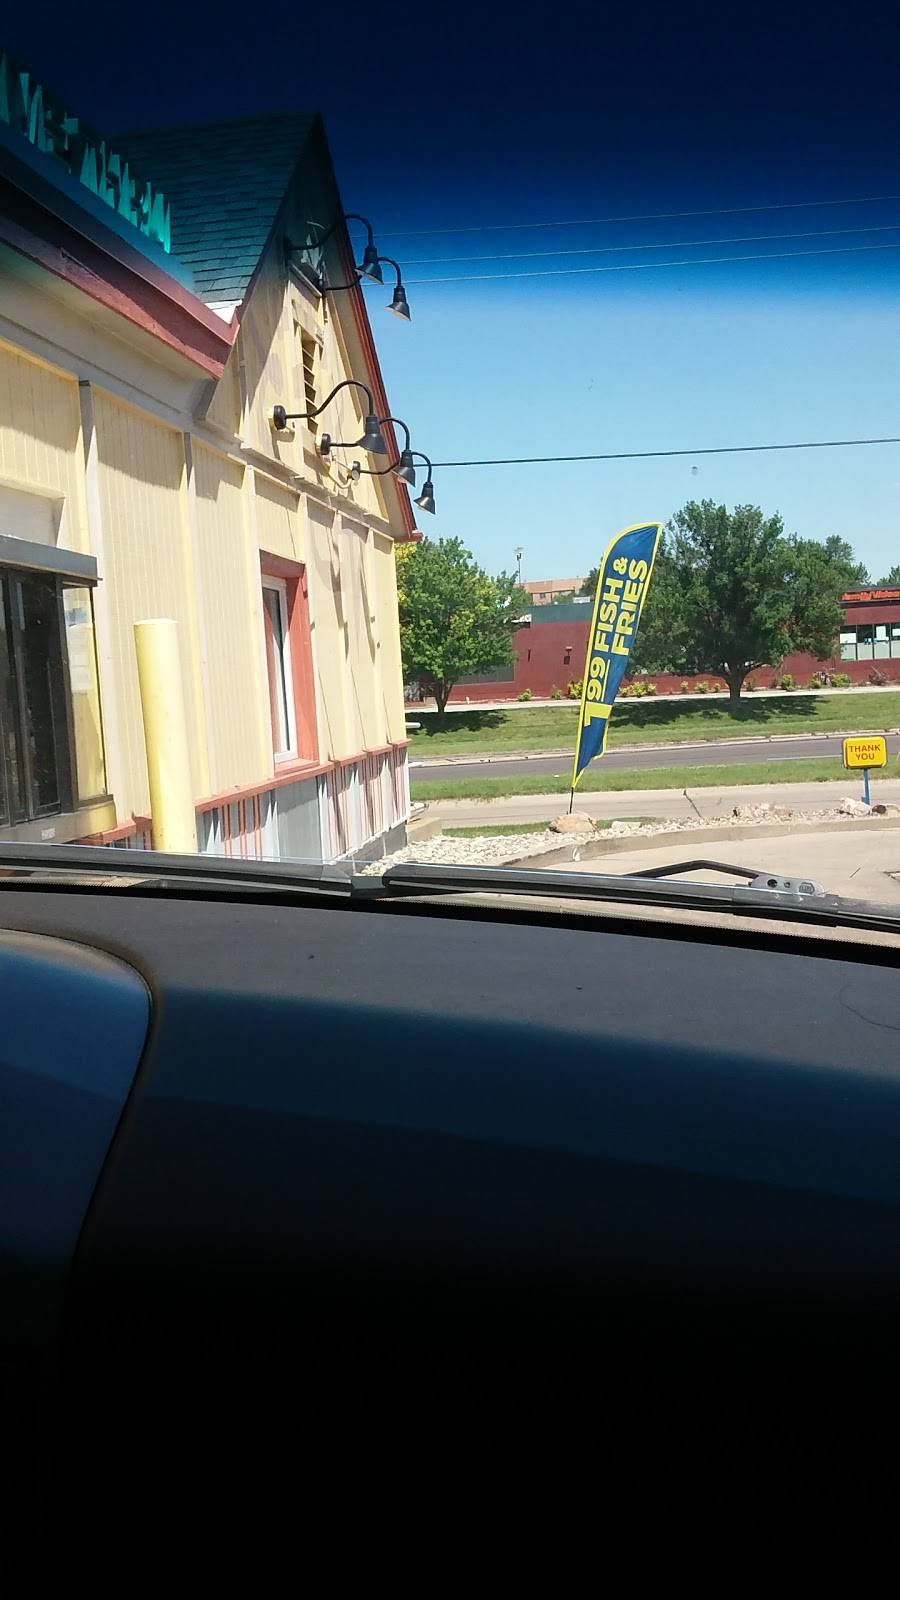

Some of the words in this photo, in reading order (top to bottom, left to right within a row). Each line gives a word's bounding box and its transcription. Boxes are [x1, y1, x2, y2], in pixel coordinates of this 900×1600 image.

[595, 579, 623, 652] FISH
[613, 557, 628, 575] &
[612, 559, 648, 656] FRIES
